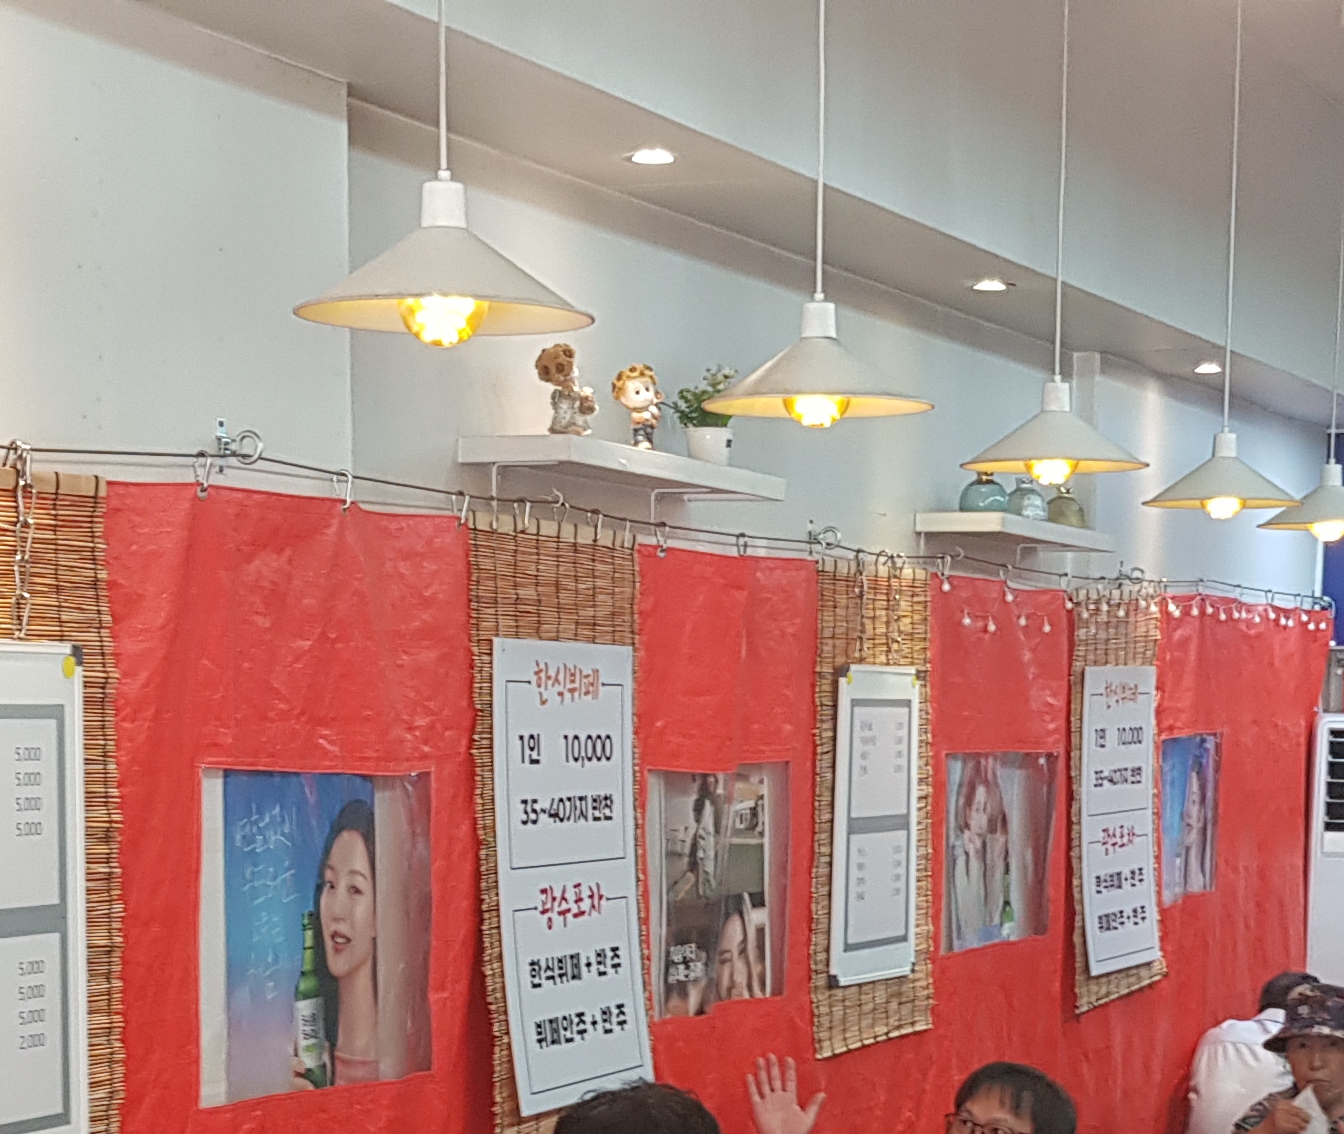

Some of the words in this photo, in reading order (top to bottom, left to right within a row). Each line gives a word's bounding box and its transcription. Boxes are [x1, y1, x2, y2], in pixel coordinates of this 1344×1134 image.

[534, 660, 600, 706] 한식뷔페
[518, 733, 540, 765] 1인
[563, 734, 613, 768] 10,000
[520, 795, 588, 825] 35~40가지
[591, 793, 613, 821] 반찬
[539, 882, 605, 930] 광수포차
[529, 953, 582, 989] 한식뷔페
[535, 1012, 587, 1049] 뷔페안주
